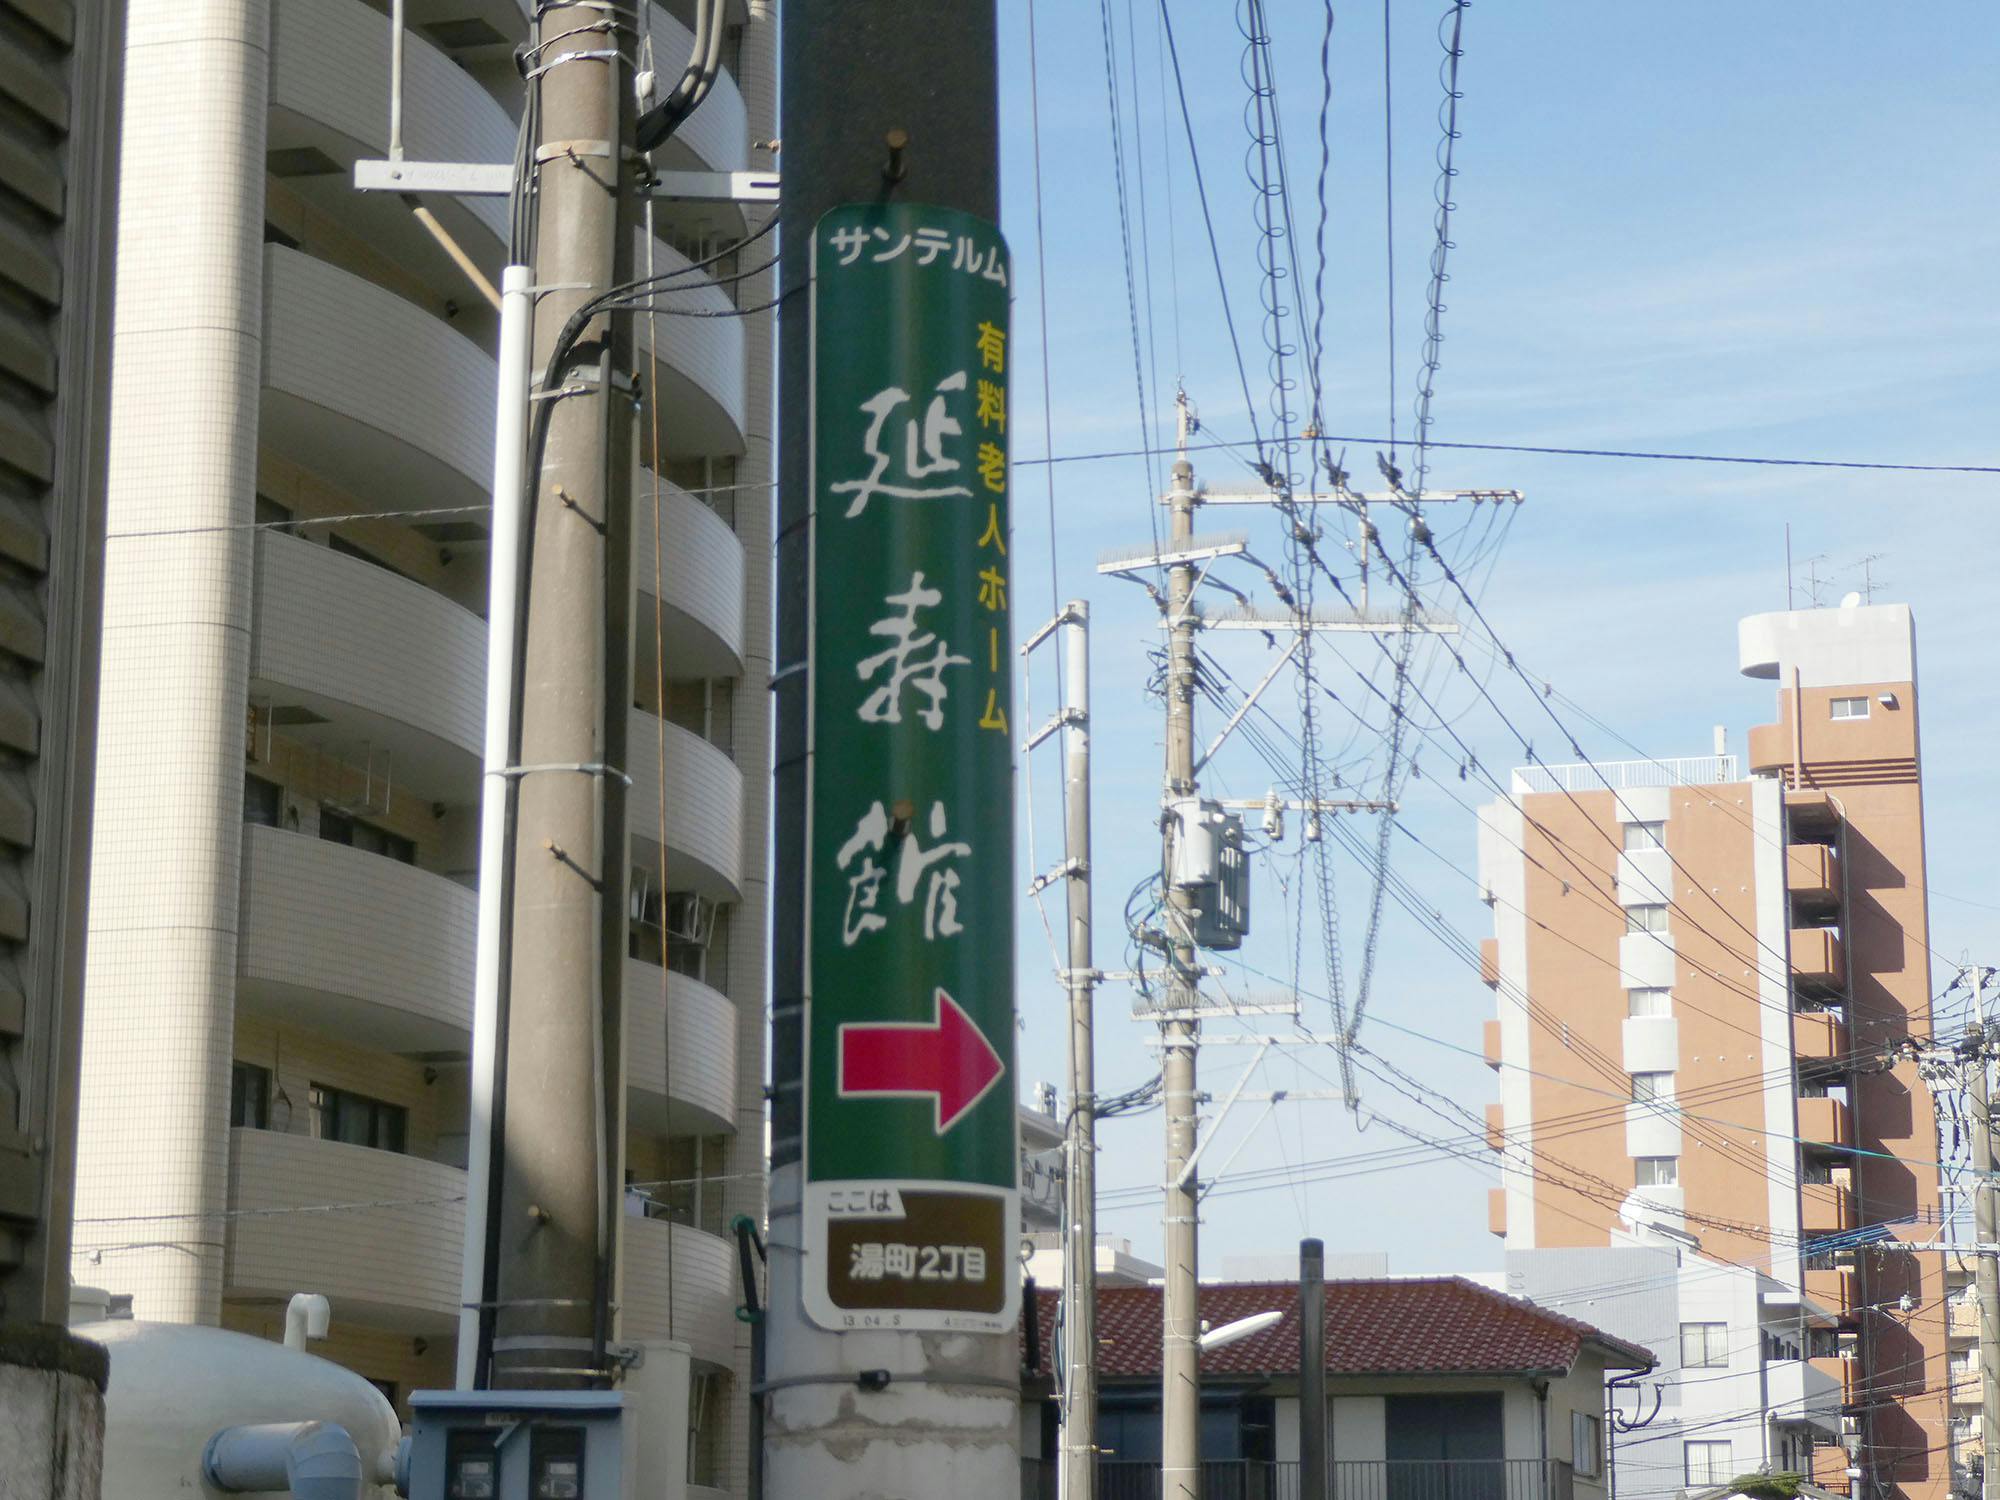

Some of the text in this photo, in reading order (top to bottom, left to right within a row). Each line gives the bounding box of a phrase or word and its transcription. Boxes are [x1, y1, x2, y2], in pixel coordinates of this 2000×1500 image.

[829, 226, 1007, 288] サンテルム
[977, 321, 1008, 736] 有料老人ホーム
[828, 1189, 892, 1212] ここは
[850, 1242, 986, 1281] 湯町2丁目
